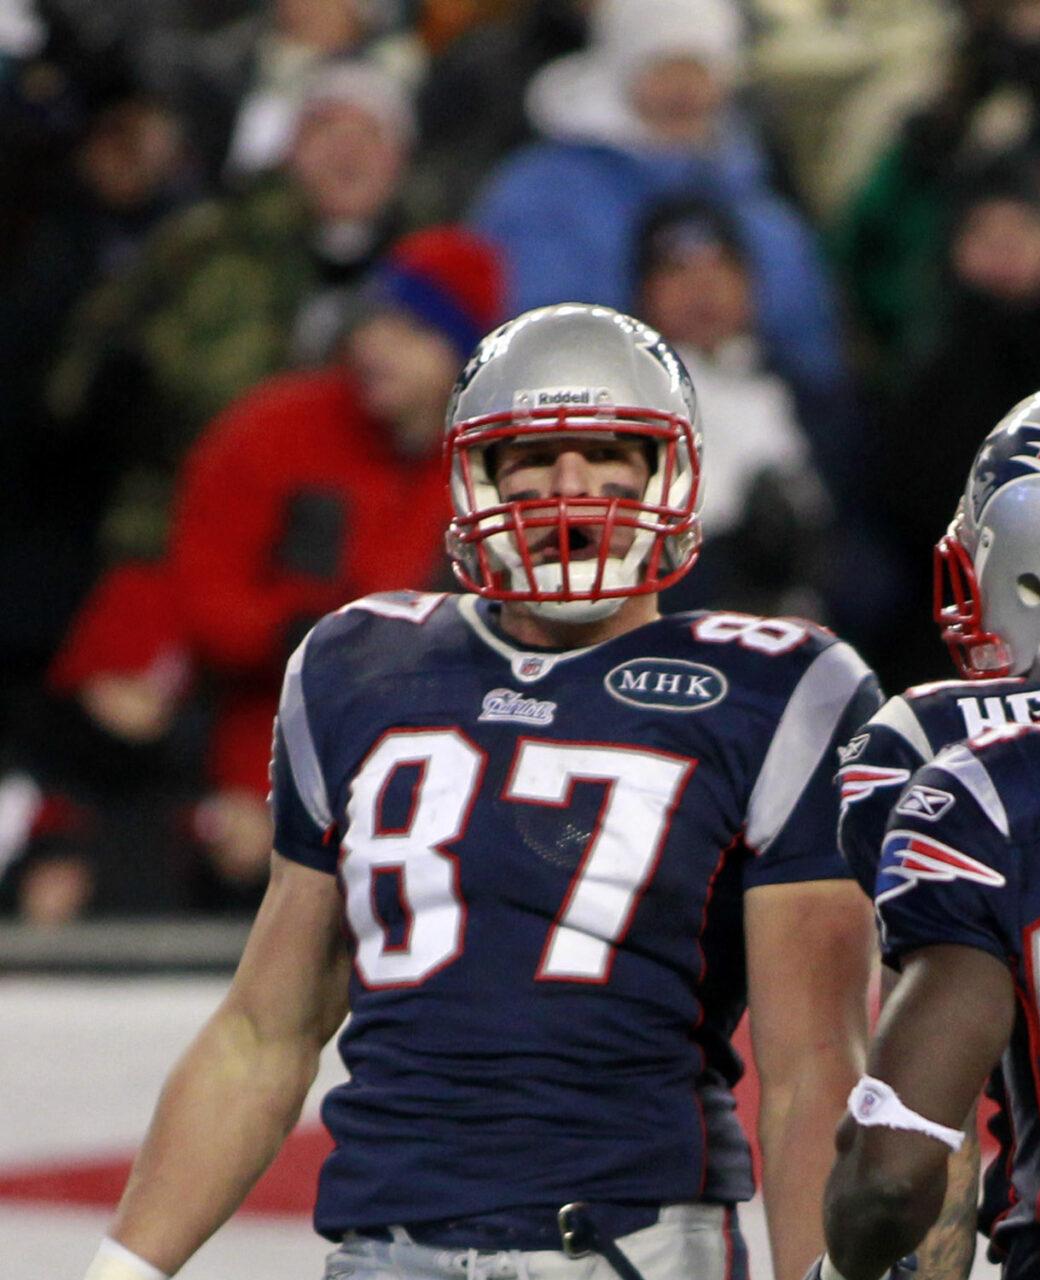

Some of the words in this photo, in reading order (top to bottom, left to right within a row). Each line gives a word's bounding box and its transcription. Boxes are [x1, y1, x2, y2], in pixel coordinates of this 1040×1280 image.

[539, 390, 590, 405] Riddell
[618, 669, 715, 698] MHK
[339, 726, 698, 990] 87
